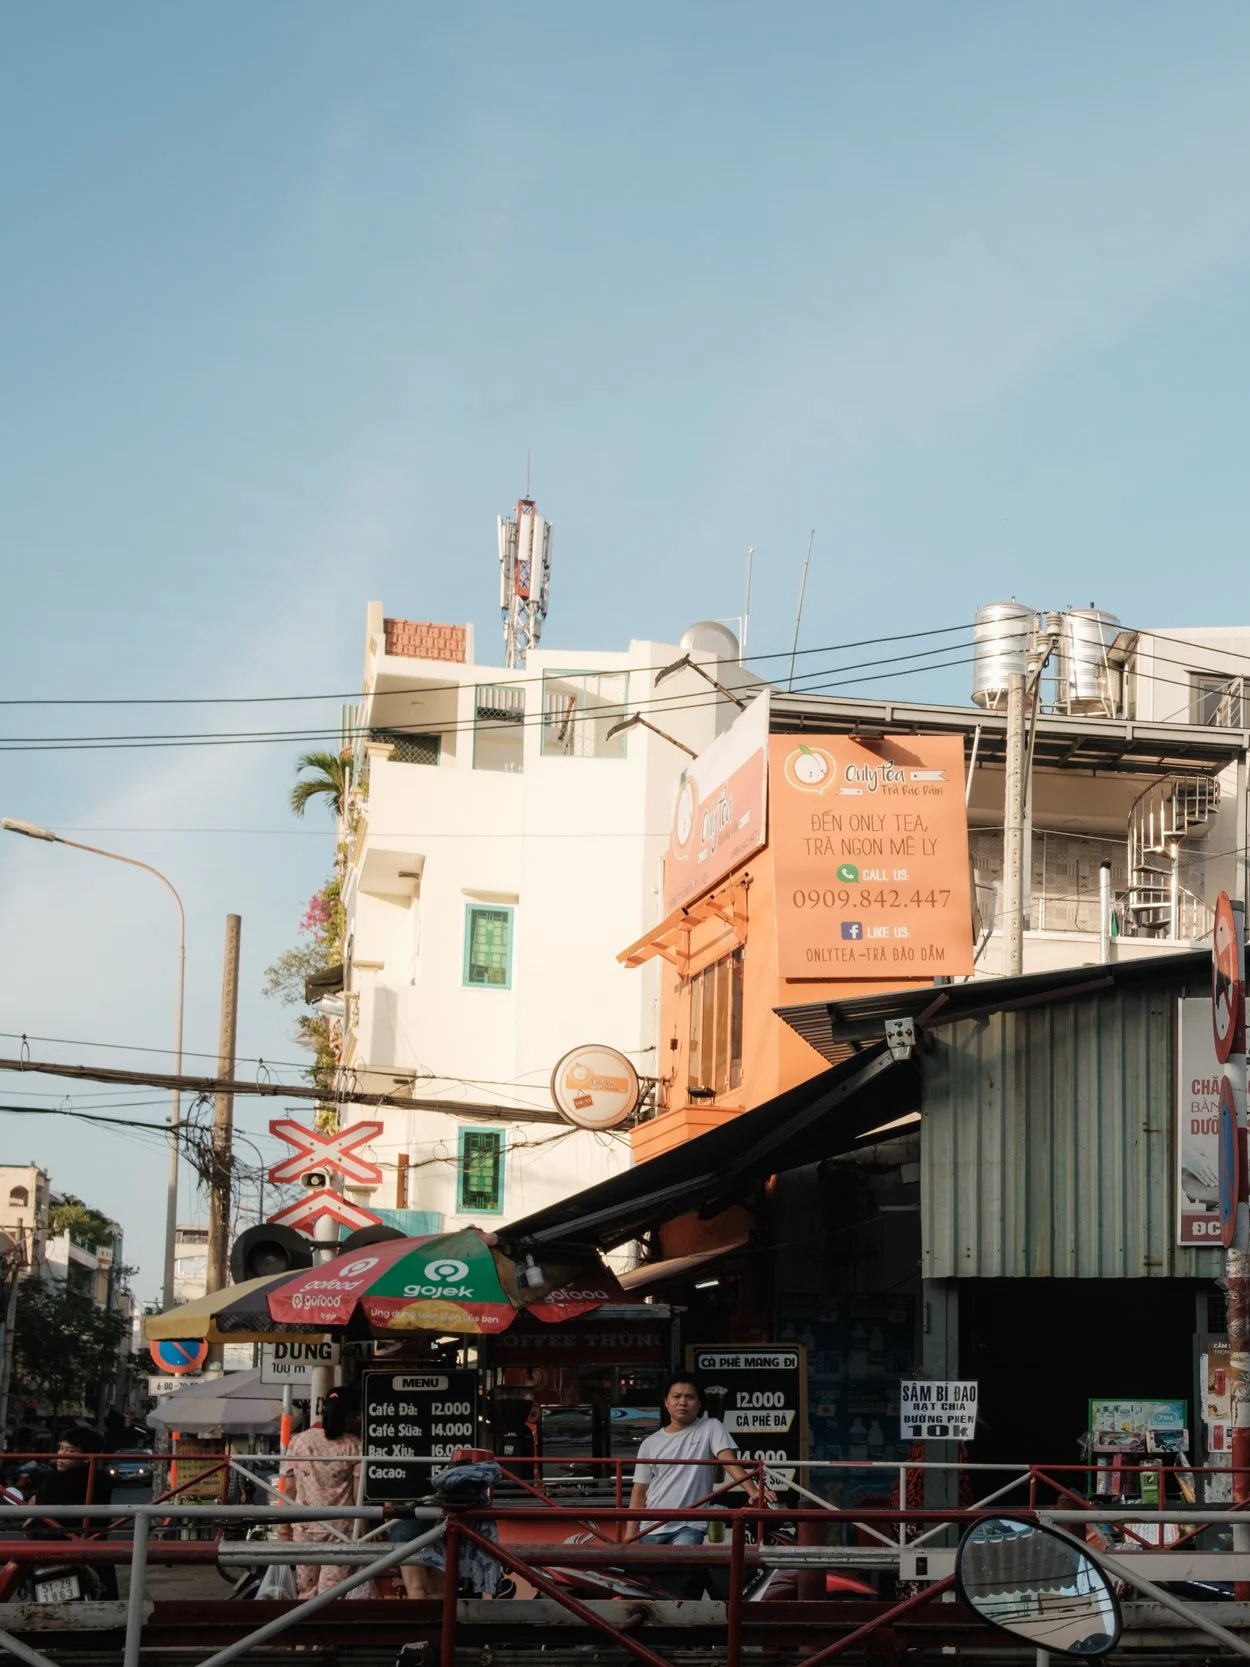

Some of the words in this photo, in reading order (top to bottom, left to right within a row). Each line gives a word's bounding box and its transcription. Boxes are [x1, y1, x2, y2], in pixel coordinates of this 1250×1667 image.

[811, 810, 842, 832] ĐẾN
[850, 814, 886, 832] ONLY
[893, 814, 928, 833] TEA,
[803, 837, 835, 855] TRÀ
[841, 838, 883, 855] NGON
[890, 836, 915, 856] MÊ
[922, 838, 938, 855] LY
[862, 869, 888, 881] CALL
[894, 869, 911, 881] US:
[793, 889, 951, 909] 0909.842.447
[867, 927, 889, 939] LIKE
[894, 927, 911, 939] US:
[1192, 1076, 1220, 1096] CHĂ
[1191, 1097, 1220, 1113] BẰN
[1191, 1115, 1220, 1135] DƯỠ
[1192, 1221, 1222, 1236] ĐC
[300, 1279, 365, 1292] gofood
[404, 1284, 474, 1299] gojek
[304, 1294, 342, 1310] gofood
[370, 1308, 390, 1319] Ứng
[481, 1315, 499, 1326] bạn
[272, 1363, 290, 1374] 100
[294, 1364, 306, 1374] m
[701, 1356, 716, 1368] CÀ
[719, 1355, 741, 1368] PHÊ
[744, 1356, 780, 1368] MANG
[784, 1356, 796, 1368] ĐI
[402, 1378, 439, 1388] MENU
[903, 1382, 932, 1402] SÂM
[936, 1383, 949, 1402] BÍ
[954, 1385, 977, 1402] ĐAO
[736, 1391, 785, 1409] 12.000
[368, 1402, 395, 1417] Café
[399, 1402, 419, 1416] Đá:
[431, 1402, 471, 1416] 12.000
[913, 1403, 937, 1413] HẠT
[941, 1403, 966, 1411] CHIA
[736, 1413, 750, 1427] CÀ
[752, 1412, 771, 1427] PHÊ
[774, 1411, 788, 1427] ĐÁ
[904, 1415, 943, 1424] ĐƯỜNG
[368, 1424, 395, 1437] Café
[431, 1423, 473, 1436] 14.000
[908, 1424, 970, 1438] 10k
[368, 1465, 407, 1479] Cacao:
